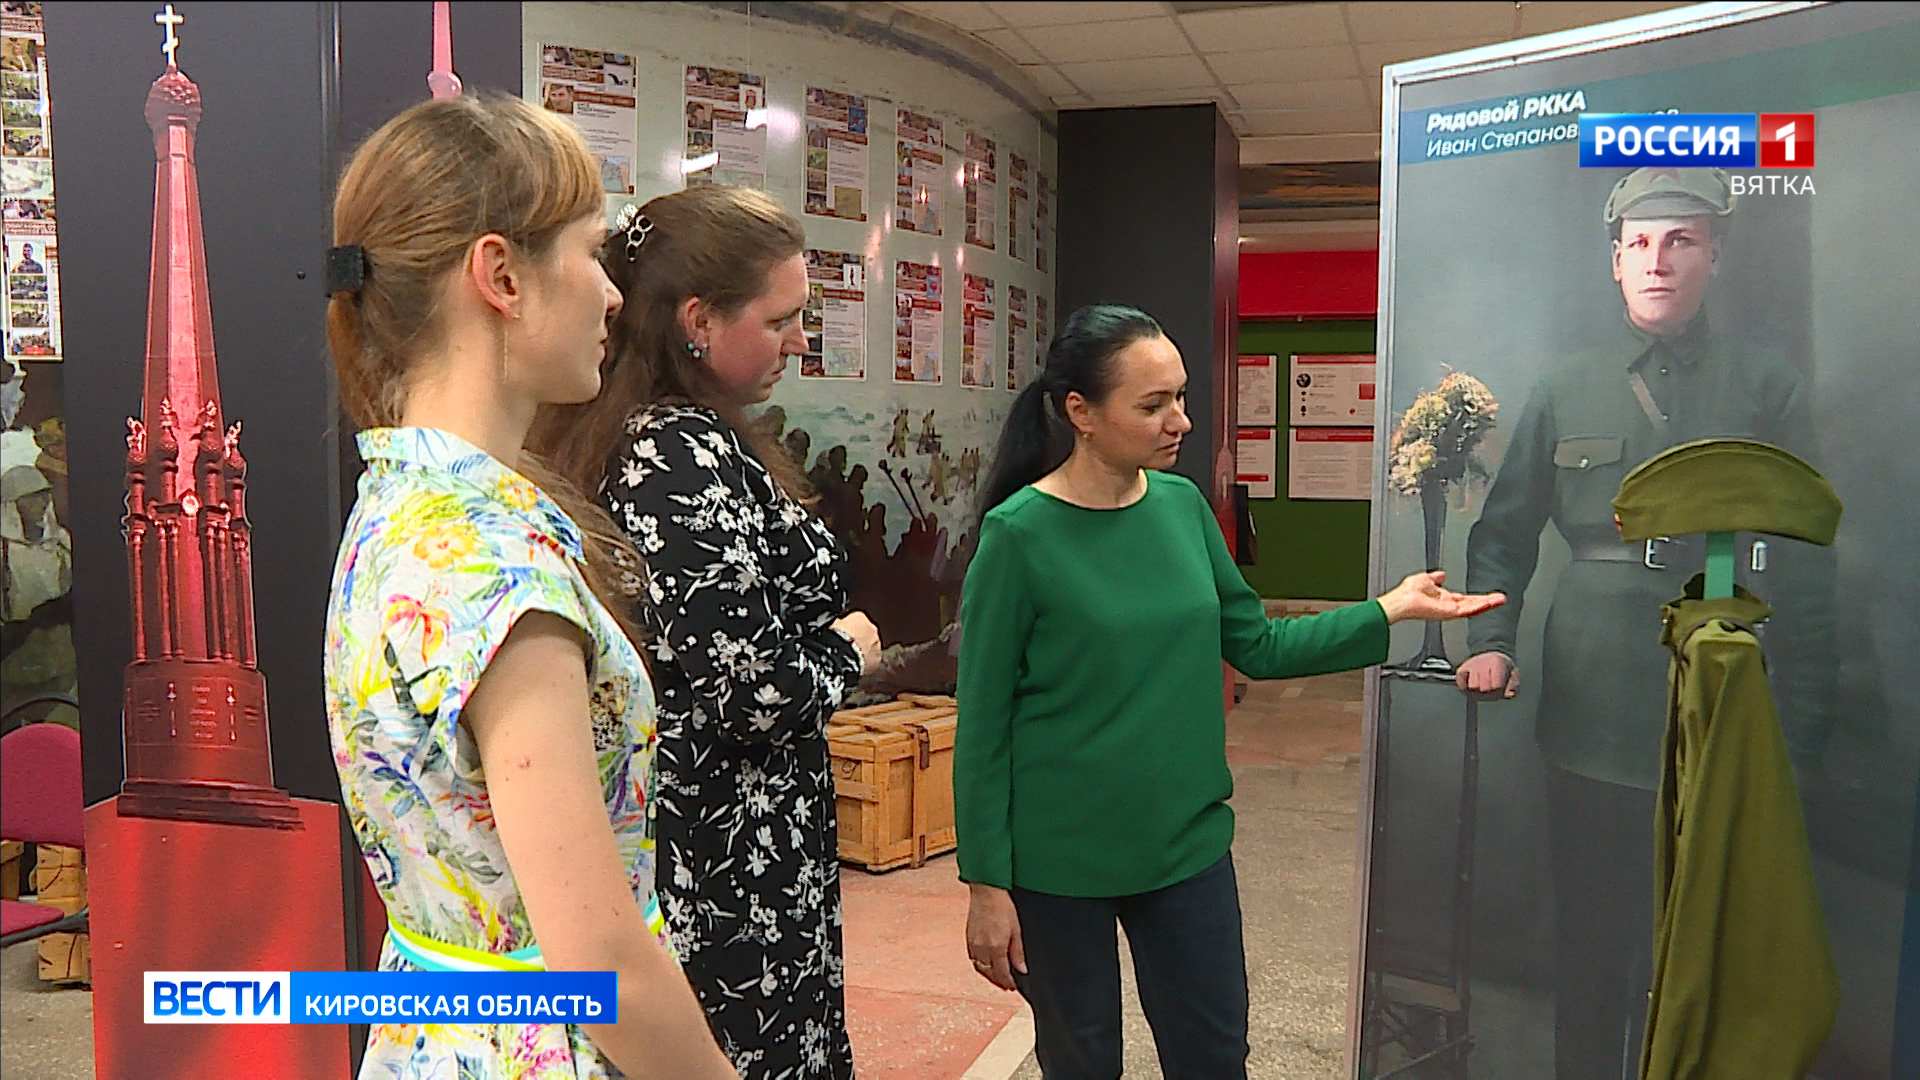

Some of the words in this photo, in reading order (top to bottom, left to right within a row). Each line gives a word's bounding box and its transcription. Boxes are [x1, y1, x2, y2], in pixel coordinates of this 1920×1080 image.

[1426, 97, 1520, 134] Рядовой
[1522, 90, 1587, 120] РККА
[1426, 138, 1478, 158] Иван
[1481, 122, 1579, 151] Степанов
